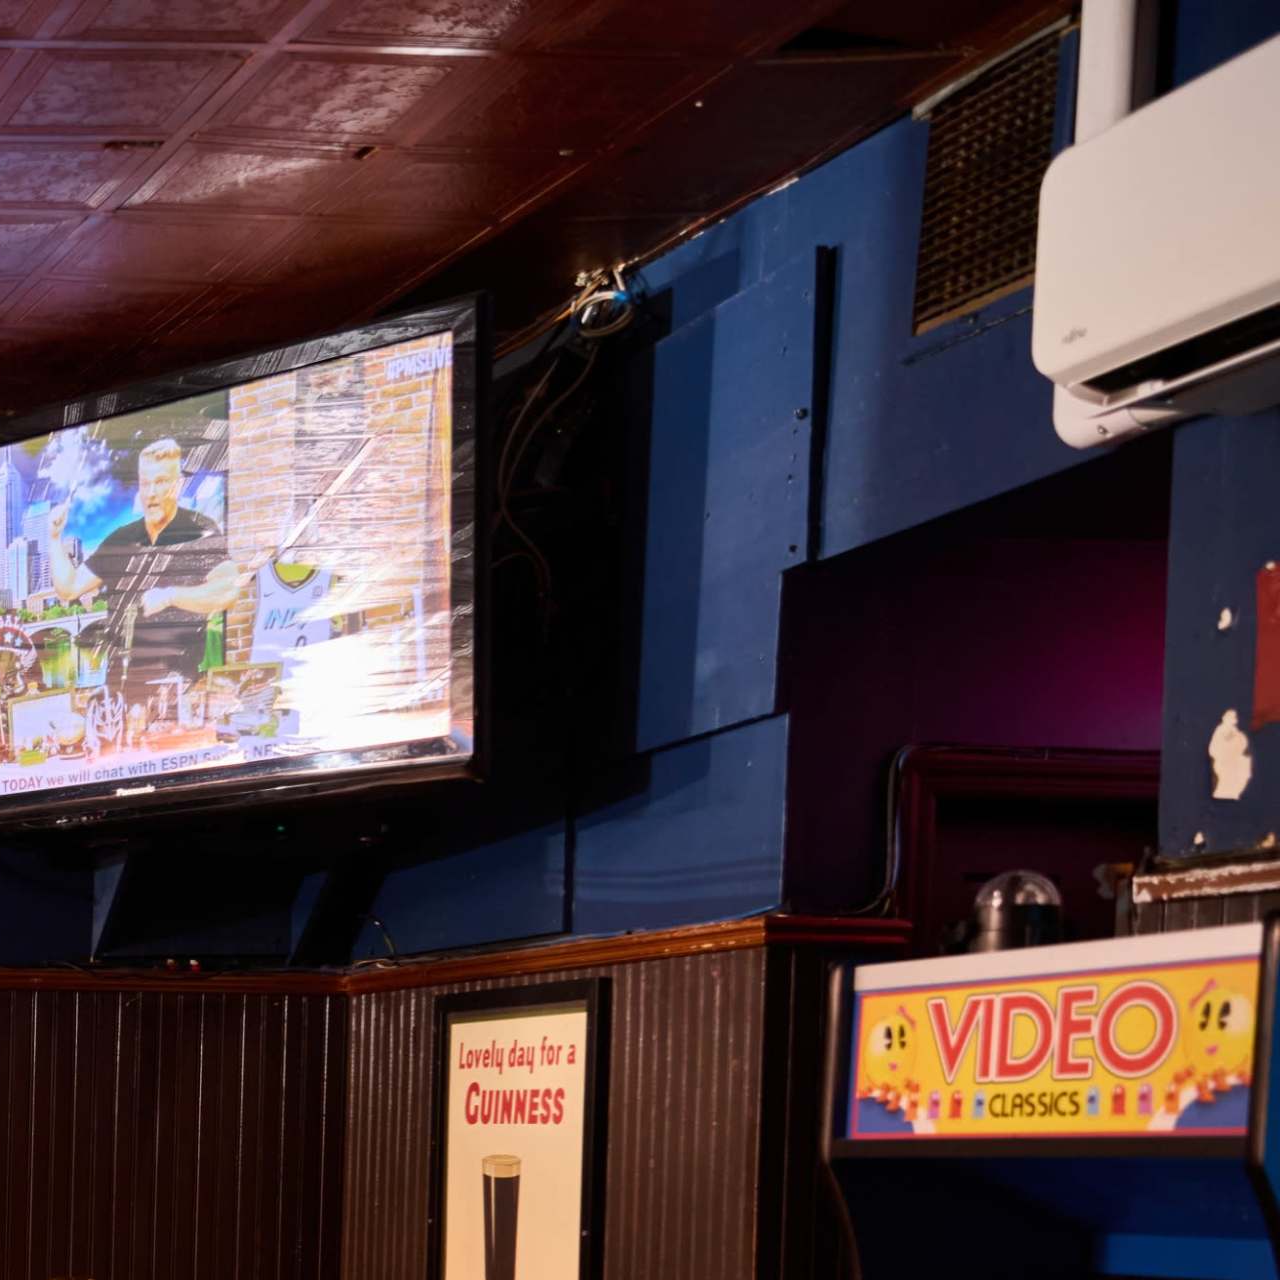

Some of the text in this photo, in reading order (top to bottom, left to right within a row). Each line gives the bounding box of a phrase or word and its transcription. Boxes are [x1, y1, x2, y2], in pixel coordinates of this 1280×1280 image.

[2, 776, 45, 793] TODAY
[47, 775, 64, 785] we
[68, 769, 91, 783] will
[94, 763, 124, 780] chat
[128, 760, 157, 778] with
[160, 754, 198, 770] ESPN
[926, 980, 1178, 1085] VIDEO
[459, 1036, 576, 1075] Lovely day for a
[465, 1081, 565, 1125] GUINNESS
[988, 1090, 1081, 1119] CLASSICS
